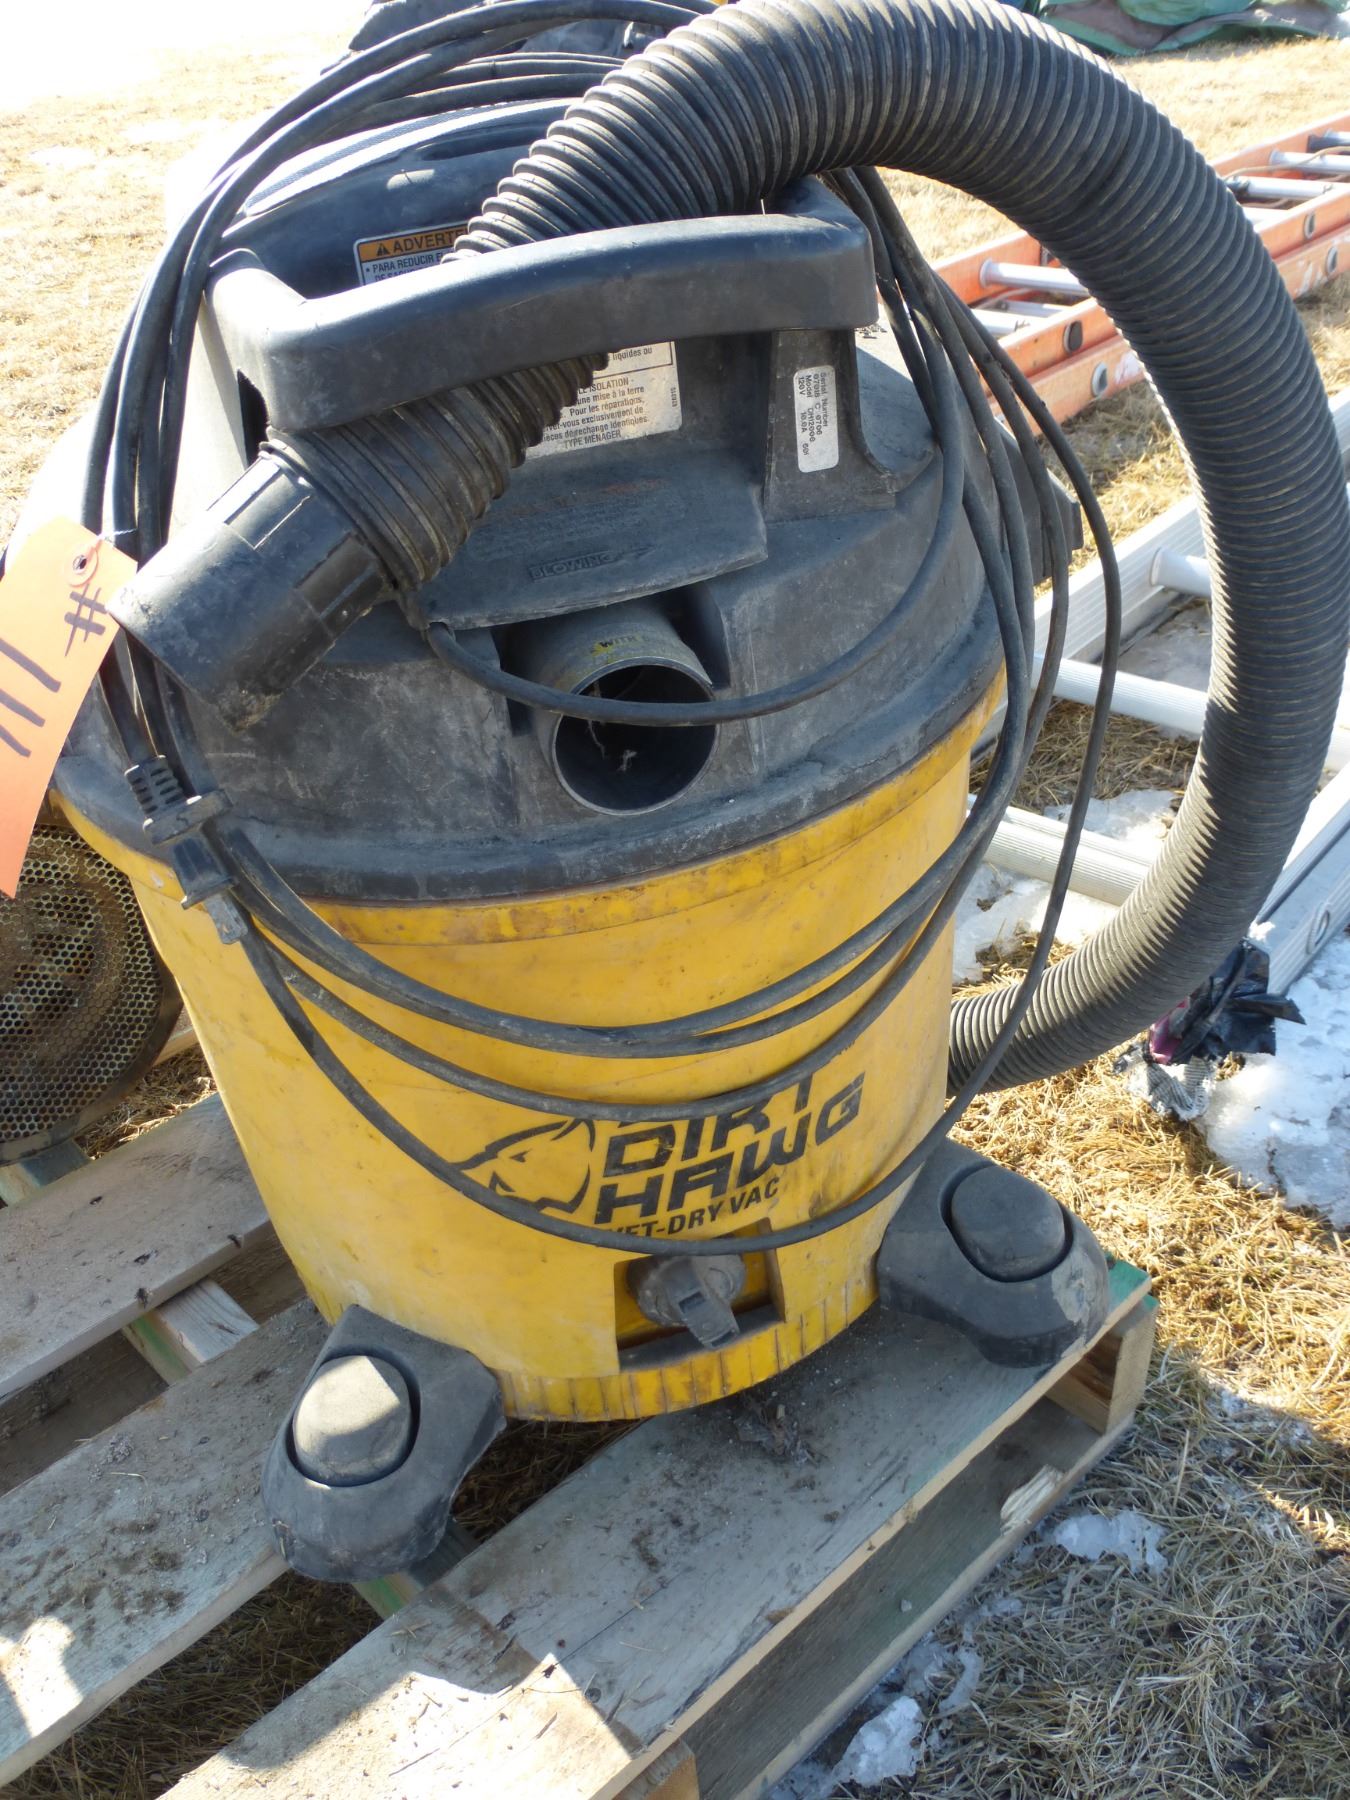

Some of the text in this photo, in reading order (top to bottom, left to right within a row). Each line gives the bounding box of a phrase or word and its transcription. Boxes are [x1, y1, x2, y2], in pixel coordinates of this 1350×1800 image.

[373, 263, 395, 273] PARA
[397, 255, 433, 269] REDUCIR
[590, 377, 629, 392] ISOLATION
[820, 372, 828, 394] Serial
[592, 392, 610, 402] mise
[618, 388, 626, 397] la
[627, 385, 645, 395] terre
[570, 407, 587, 416] Pour
[588, 404, 600, 414] les
[581, 409, 633, 424] exclusivement
[634, 405, 643, 414] de
[565, 438, 582, 449] TYPE
[594, 1072, 866, 1225] HAWG
[731, 1177, 780, 1214] VAC
